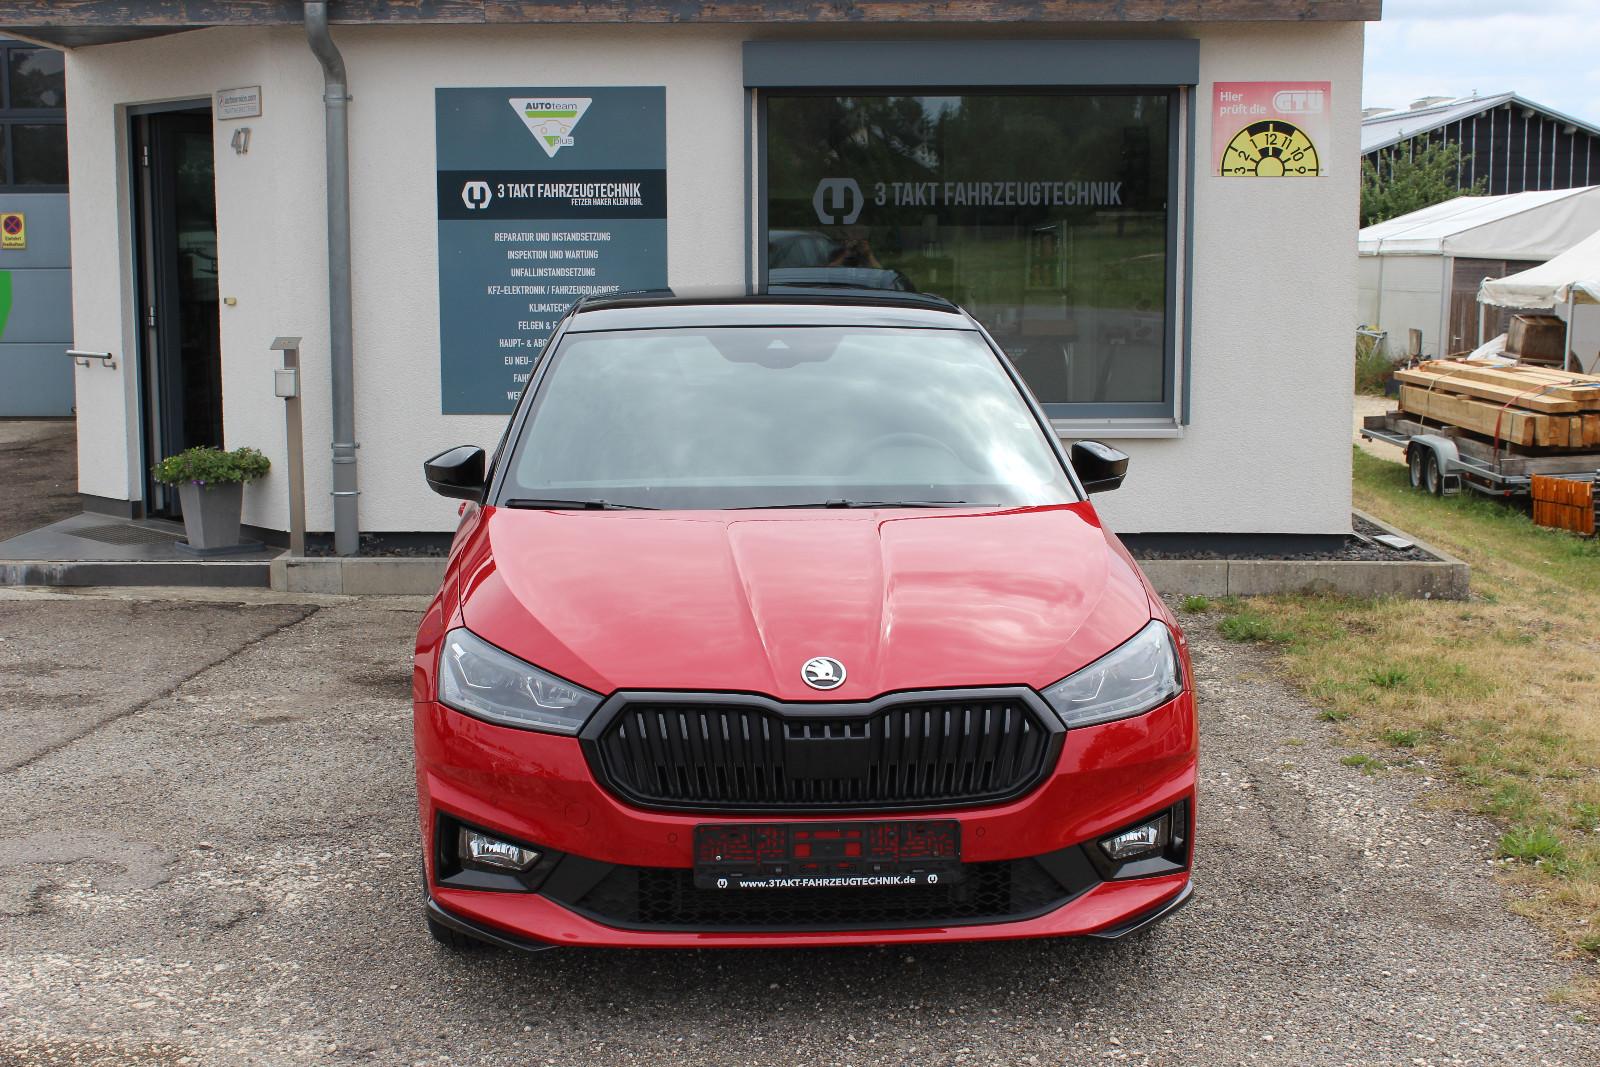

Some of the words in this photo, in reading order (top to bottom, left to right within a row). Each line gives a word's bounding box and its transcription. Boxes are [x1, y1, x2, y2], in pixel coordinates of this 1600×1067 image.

[1219, 92, 1243, 102] Hier
[1219, 104, 1248, 116] prüft
[1249, 104, 1266, 113] die
[231, 127, 251, 155] 47
[552, 136, 574, 145] plus
[1249, 138, 1259, 149] 1
[1265, 134, 1277, 146] 12
[1281, 136, 1293, 150] 11
[1238, 150, 1250, 162] 2
[1290, 147, 1305, 162] 10
[1234, 166, 1246, 175] 3
[498, 185, 505, 198] 3
[507, 184, 536, 198] TAKT
[537, 183, 641, 198] FAHRZEUGTECHNIK
[874, 182, 888, 206] 3
[892, 182, 939, 206] TAKT
[944, 181, 1123, 206] FAHRZEUGTECHNIK
[571, 198, 592, 206] FETZER
[592, 198, 612, 206] HAKER
[612, 198, 629, 206] KLEIN
[629, 197, 643, 206] GBR.
[494, 233, 535, 242] REPARATUR
[535, 233, 550, 241] UND
[551, 232, 611, 241] INSTANDSETZUNG
[507, 251, 548, 260] INSPEKTION
[549, 251, 563, 259] UND
[565, 250, 599, 259] WARTUNG
[511, 268, 596, 277] UNFALLINSTANDSETZUNG
[488, 286, 546, 295] KFZ-ELEKTRONIK
[518, 321, 544, 330] FELGEN
[545, 321, 551, 330] &
[499, 339, 525, 348] HAUPT-
[526, 339, 533, 348] &
[504, 356, 514, 366] EU
[515, 356, 533, 365] NEU-
[740, 876, 916, 888] www.3TAKT-FAHRZEUGTECHNIK.de
